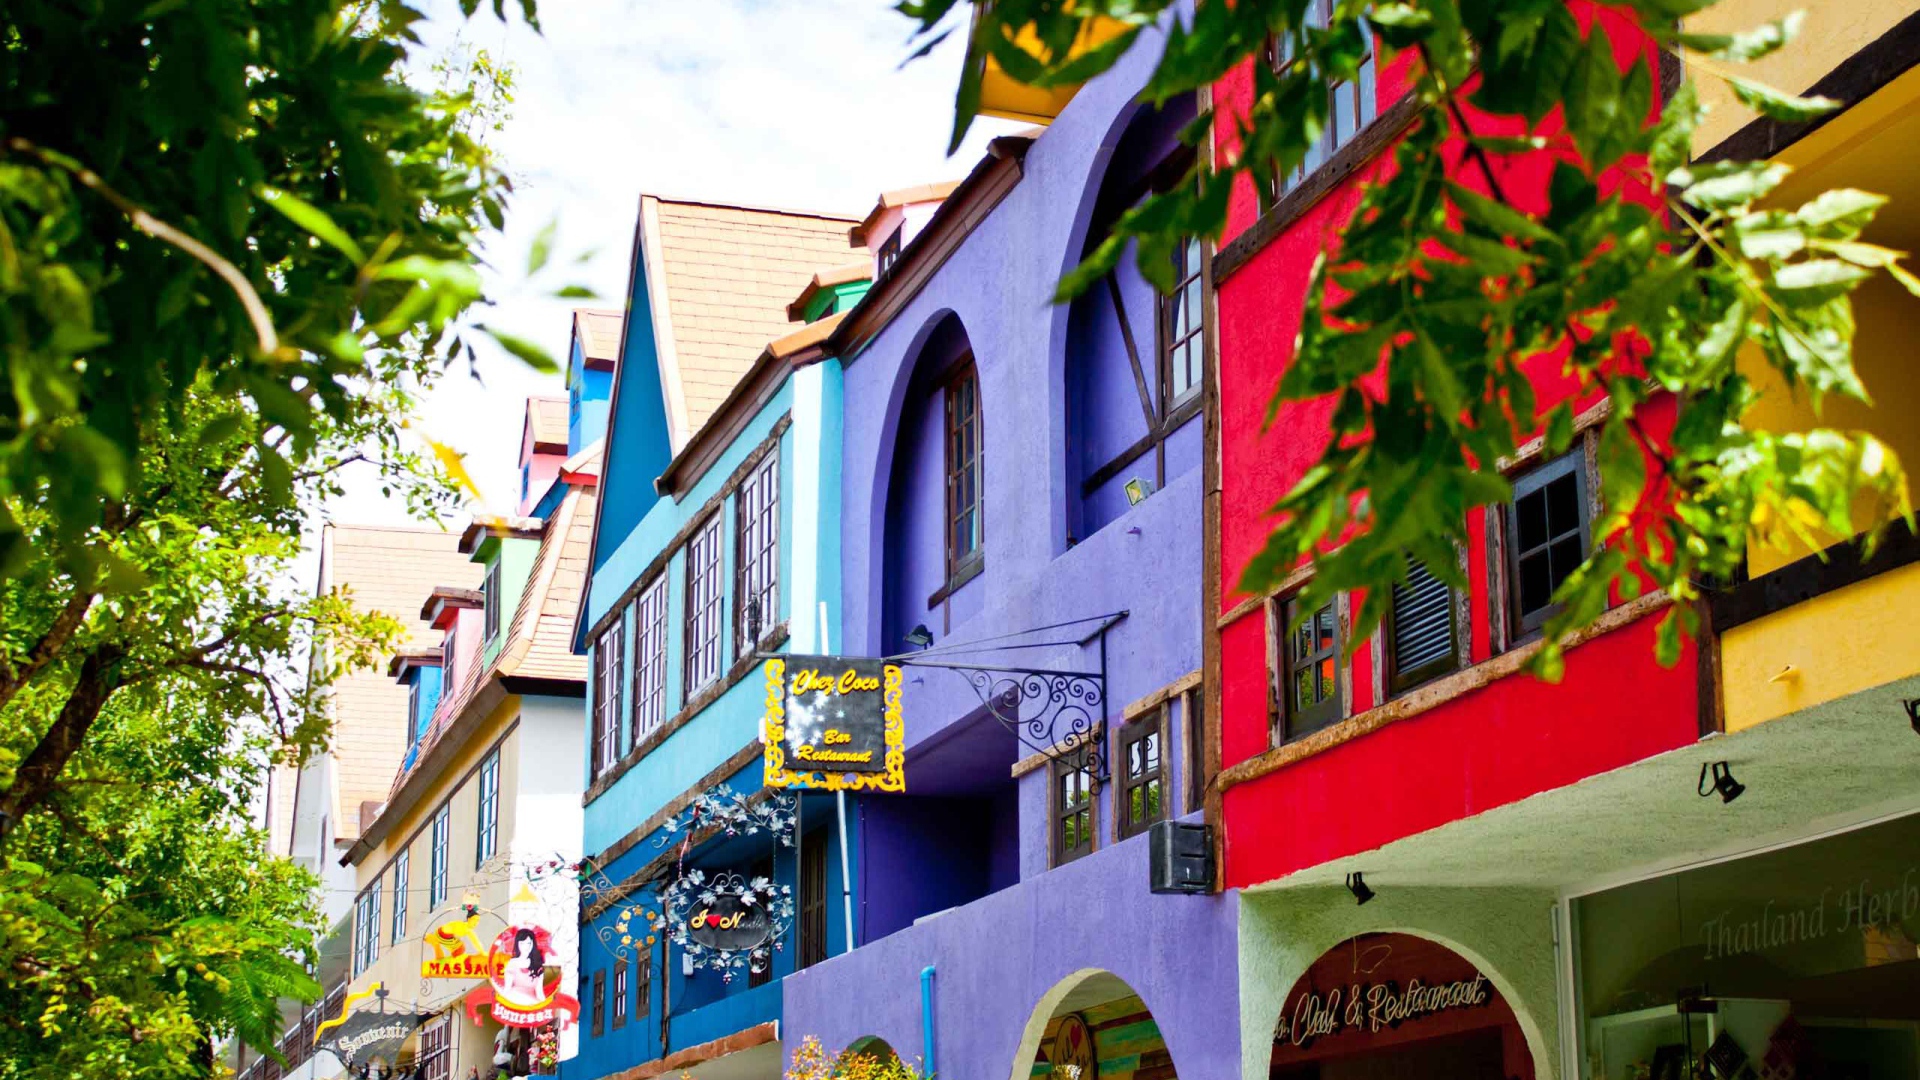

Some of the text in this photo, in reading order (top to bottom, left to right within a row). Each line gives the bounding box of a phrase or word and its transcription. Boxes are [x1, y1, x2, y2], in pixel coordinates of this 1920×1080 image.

[793, 668, 880, 695] Chez Coco
[797, 745, 873, 763] Restaurant
[824, 729, 852, 746] Bar
[1700, 886, 1833, 959] Thailand
[1344, 984, 1364, 1031] &
[1367, 972, 1487, 1033] Restaurant
[338, 1021, 409, 1062] Souvenir
